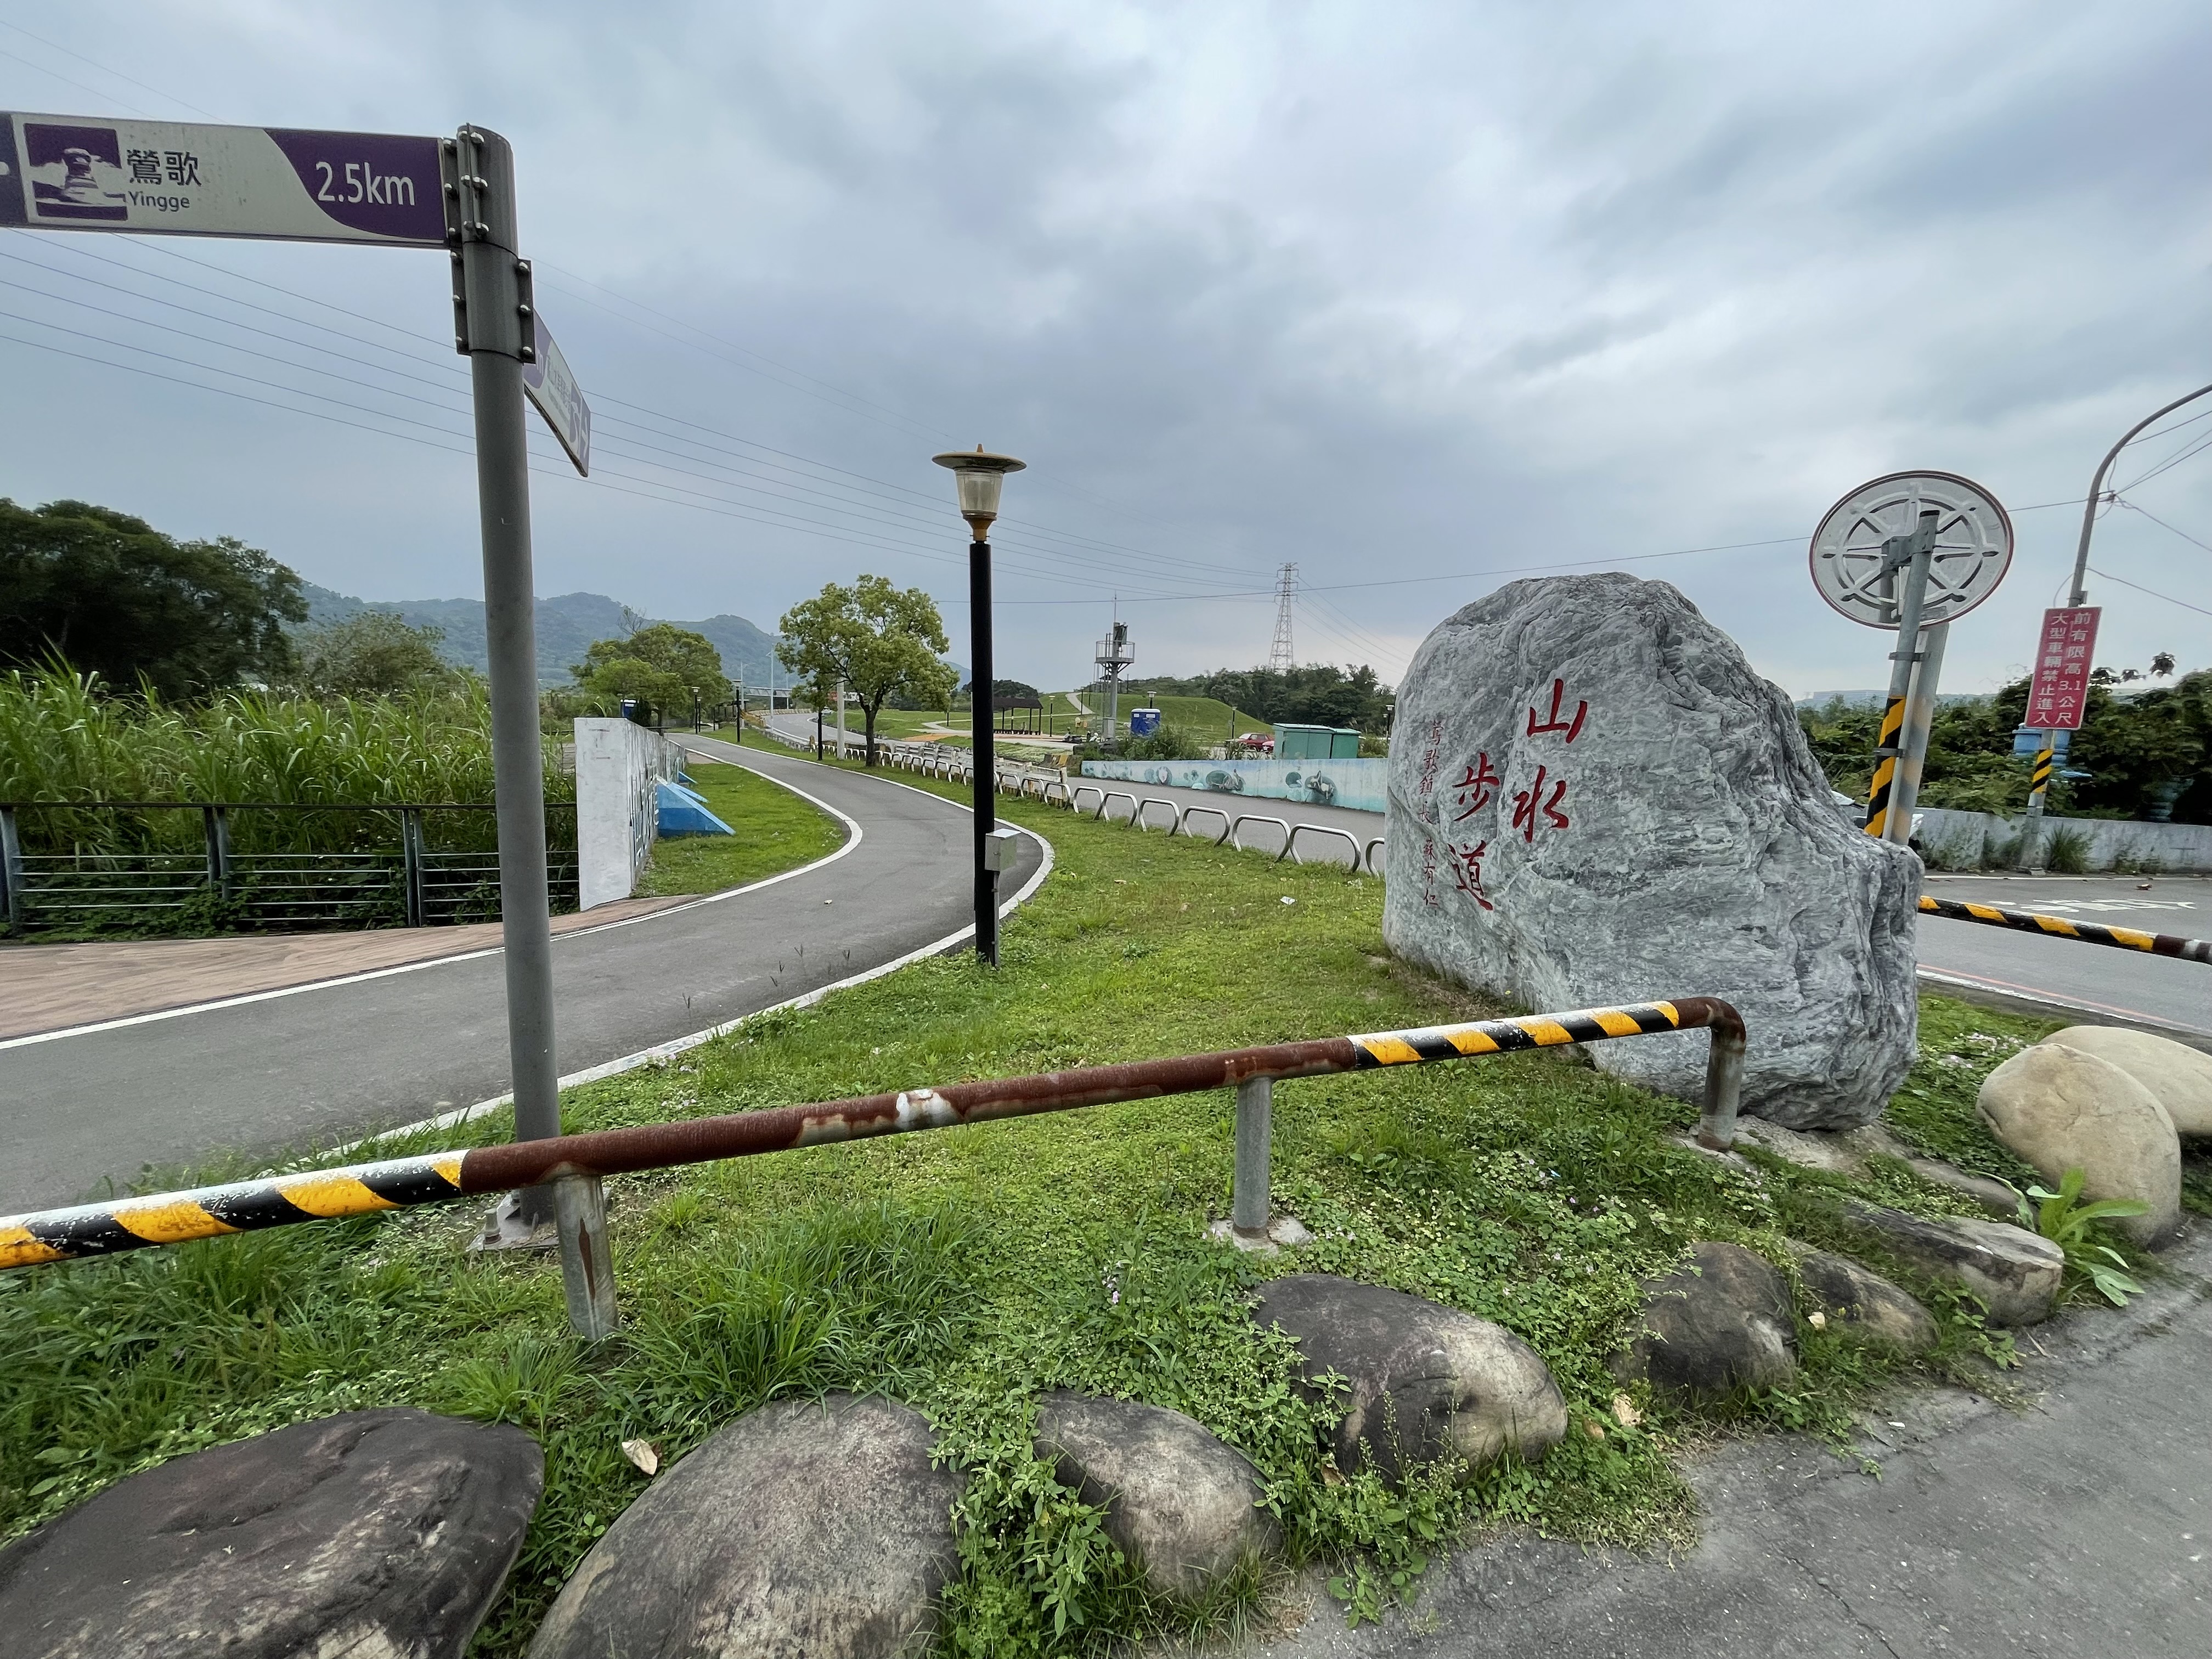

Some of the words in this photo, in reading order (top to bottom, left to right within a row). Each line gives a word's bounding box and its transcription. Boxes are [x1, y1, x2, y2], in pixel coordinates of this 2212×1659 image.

[127, 149, 202, 187] 鶯歌
[315, 161, 415, 206] 2.5km
[128, 191, 190, 211] Yingge
